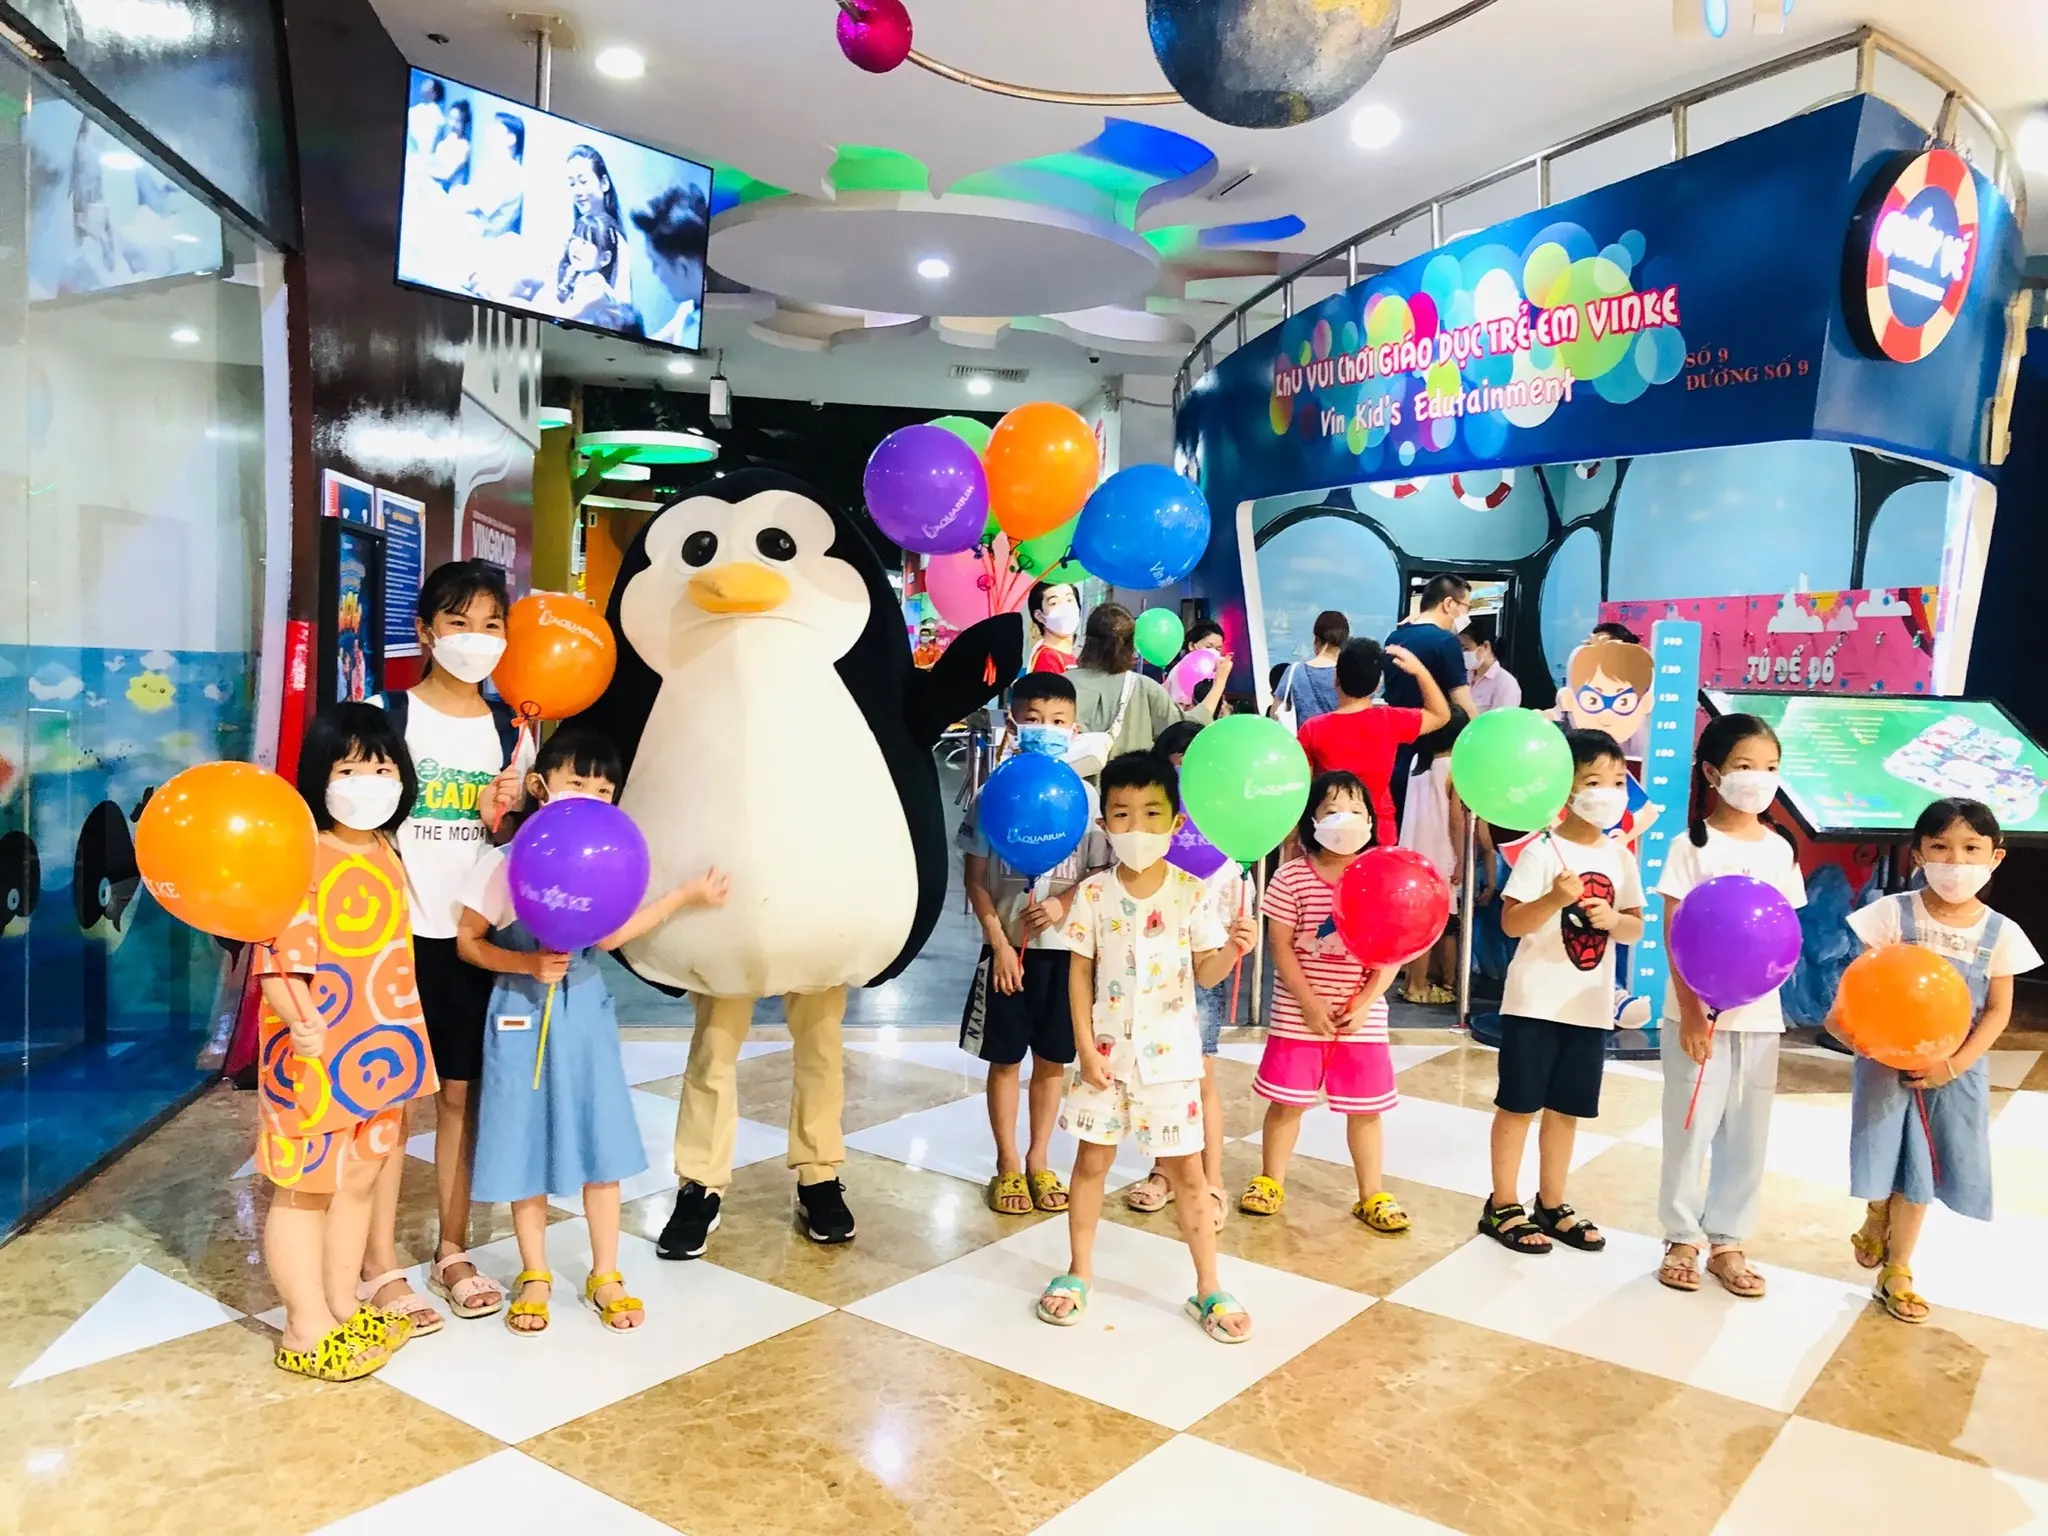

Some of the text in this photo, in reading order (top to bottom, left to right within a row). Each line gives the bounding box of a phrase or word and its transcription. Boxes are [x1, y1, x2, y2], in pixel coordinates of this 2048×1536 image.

[1306, 360, 1334, 393] VUI
[1378, 330, 1434, 376] GIÁO
[1438, 324, 1484, 370] DỤC
[1487, 299, 1531, 354] TRẺ
[1536, 304, 1580, 347] EM
[1685, 342, 1729, 368] SỐ 9
[1764, 352, 1792, 380] SỐ
[1797, 359, 1809, 376] 9
[1320, 366, 1575, 438] Vin Kid's Edutainment
[414, 825, 442, 841] THE
